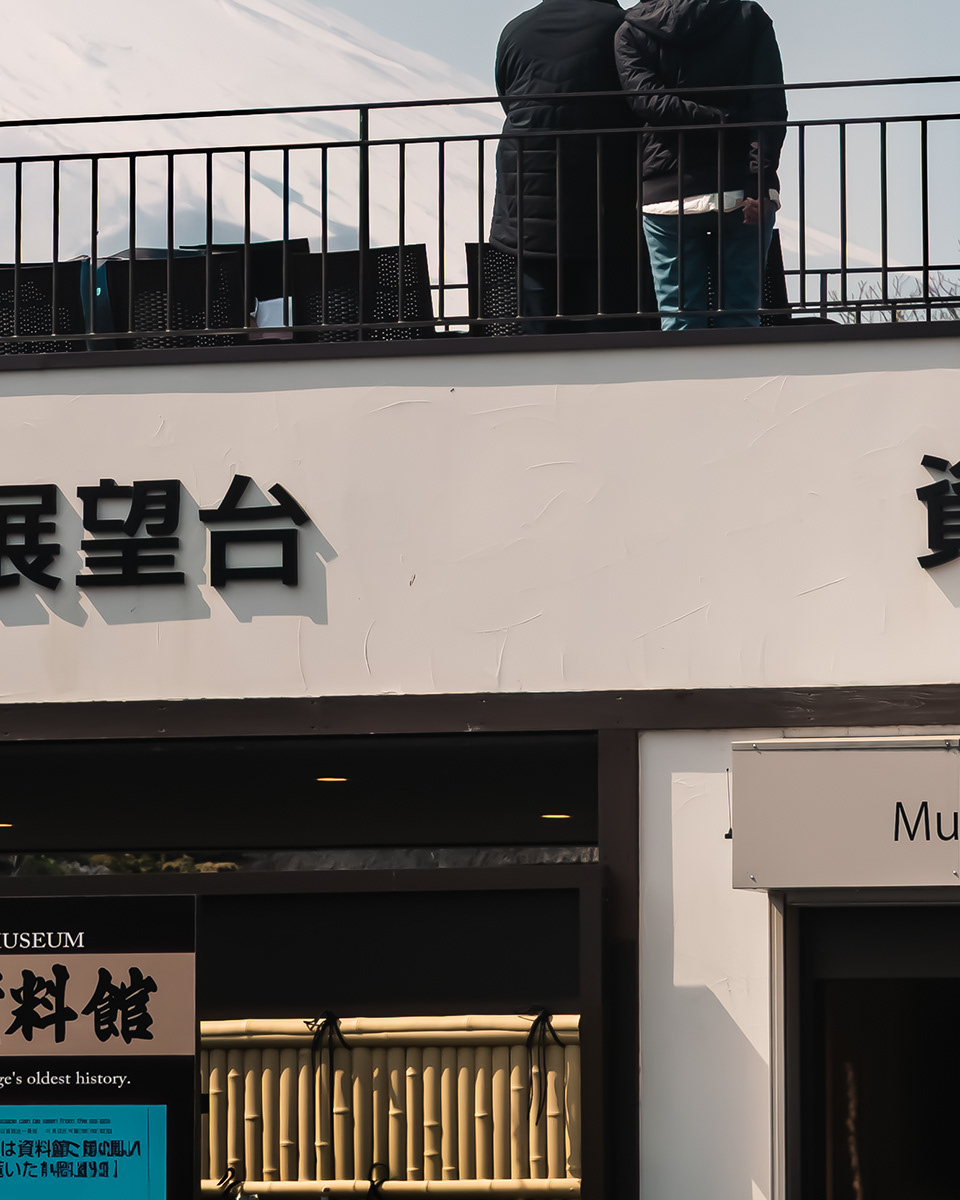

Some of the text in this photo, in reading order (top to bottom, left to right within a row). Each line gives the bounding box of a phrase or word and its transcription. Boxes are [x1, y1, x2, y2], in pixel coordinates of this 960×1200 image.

[894, 801, 959, 842] Mu
[26, 1070, 72, 1085] oldest
[75, 1070, 132, 1089] history.
